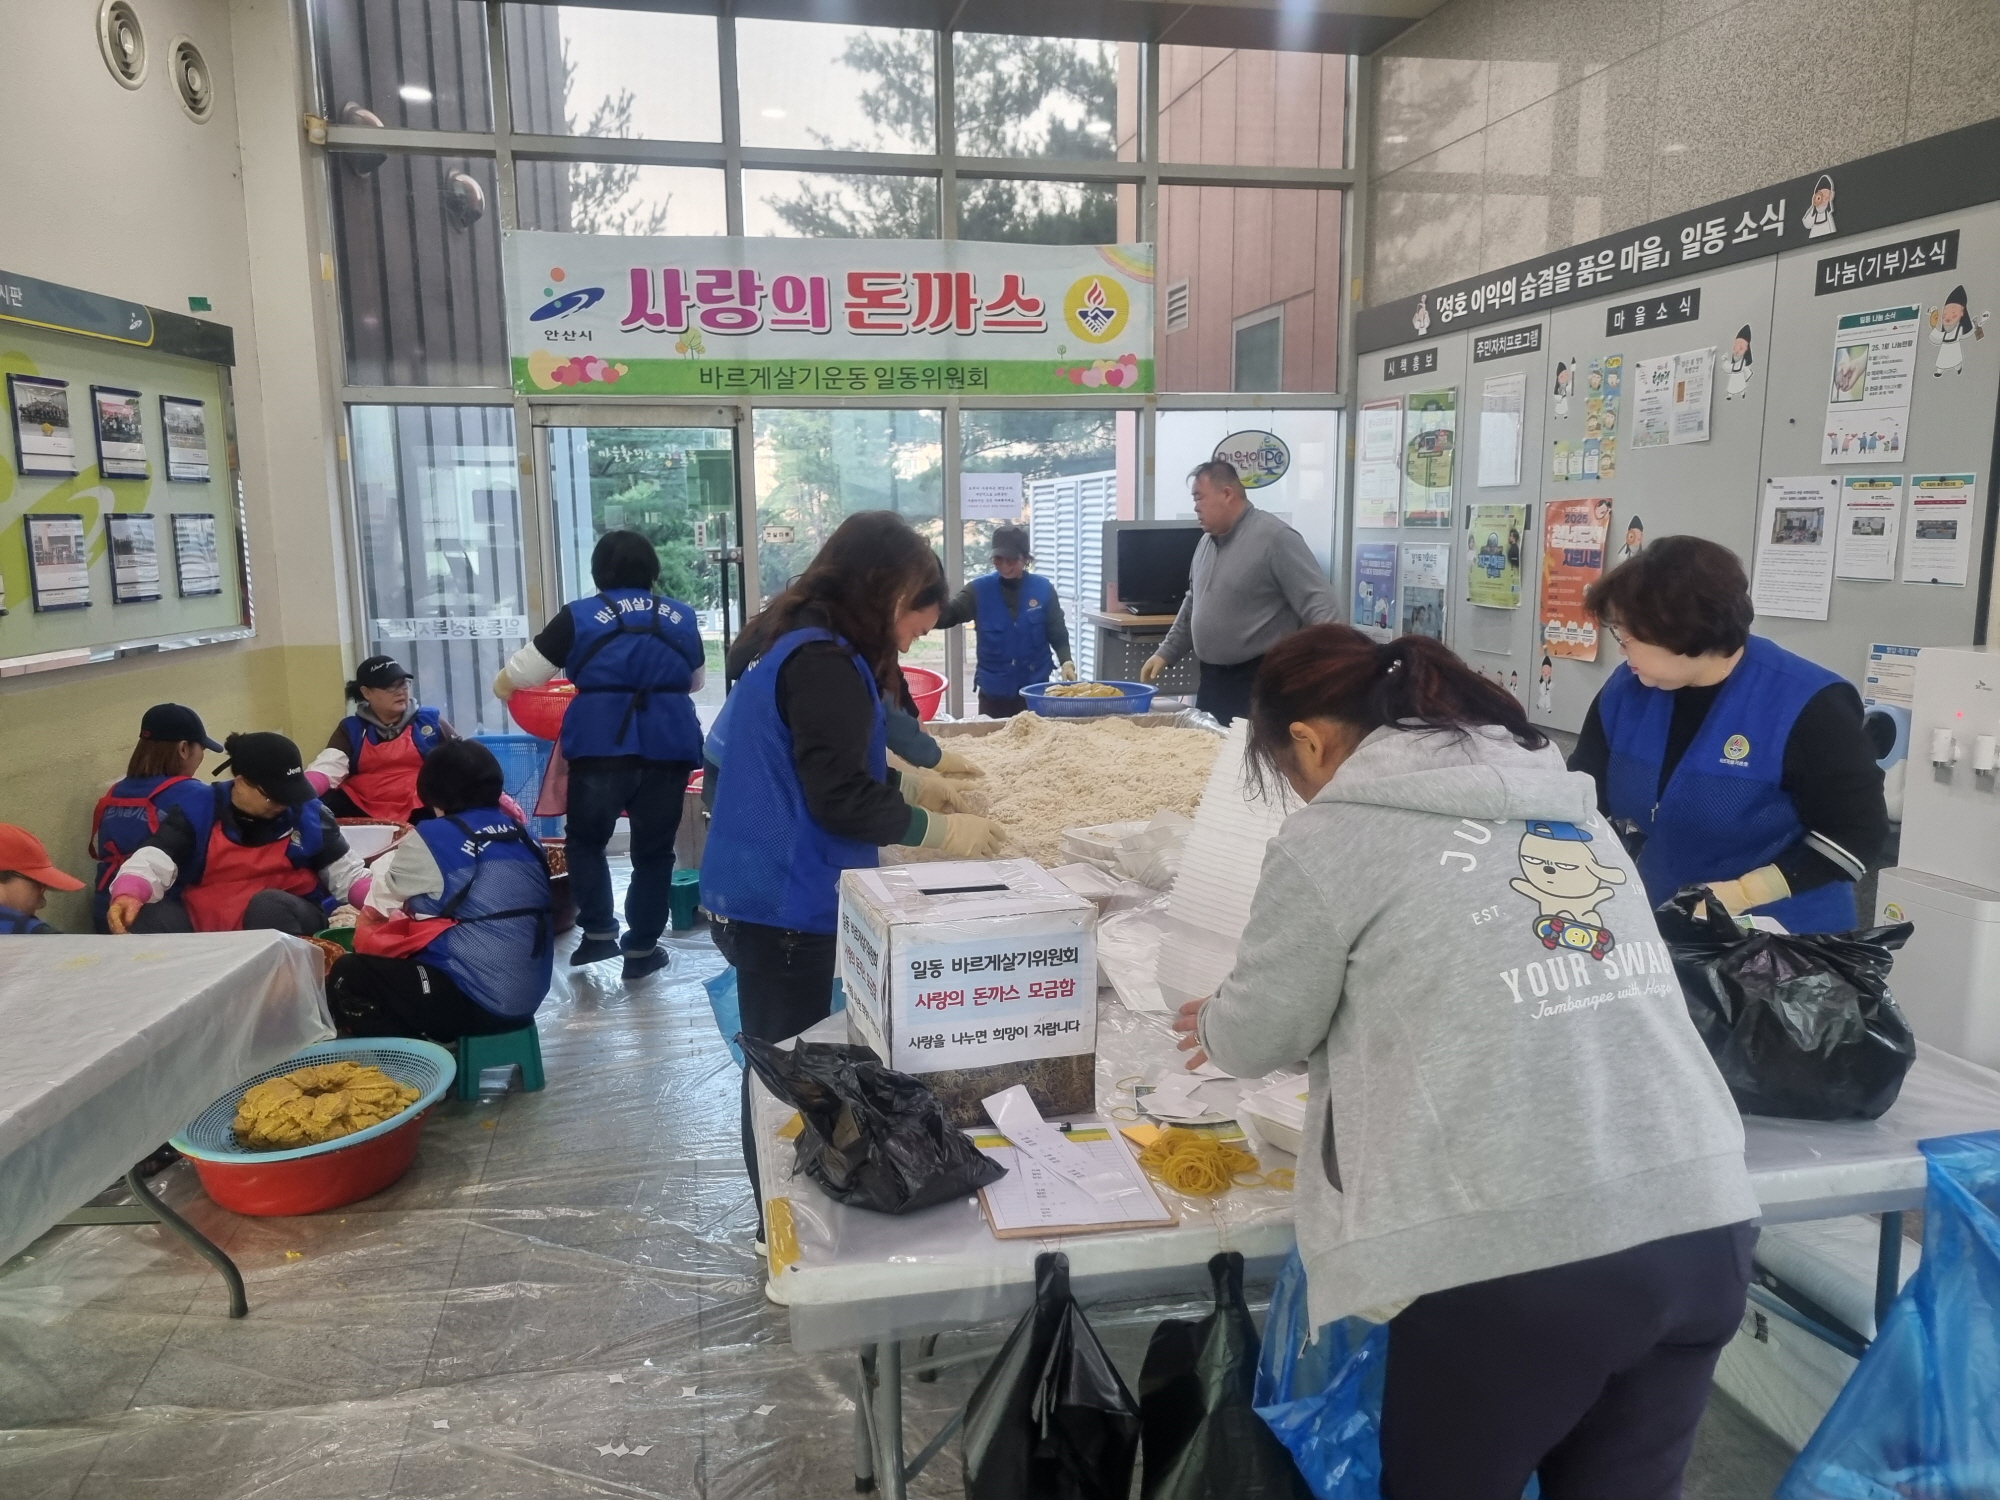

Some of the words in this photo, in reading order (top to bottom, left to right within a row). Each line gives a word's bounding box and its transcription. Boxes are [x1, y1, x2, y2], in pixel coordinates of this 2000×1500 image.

[1471, 277, 1517, 313] 이익의
[1520, 261, 1573, 303] 숨결을
[1576, 249, 1616, 287] 품은
[1680, 217, 1727, 261] 일동
[1732, 199, 1786, 244] 소식
[1825, 239, 1947, 287] 나눔(기부)소식
[621, 266, 832, 336] 사랑의
[843, 270, 1049, 336] 돈까스
[544, 329, 593, 342] 안산시
[1476, 328, 1539, 357] 주민자치프로그램
[1565, 513, 1588, 524] 2025
[1471, 904, 1507, 926] EST.
[909, 958, 945, 980] 일동
[951, 946, 1079, 976] 바르게살기위원회
[1499, 952, 1592, 1005] YOUR
[914, 988, 965, 1011] 사랑의
[971, 984, 1021, 1006] 돈까스
[1027, 978, 1076, 999] 모금함
[1618, 981, 1640, 999] with
[908, 1033, 946, 1050] 사랑을
[951, 1029, 988, 1047] 나누면
[992, 1025, 1029, 1041] 희망이
[1033, 1019, 1081, 1037] 자랍니다
